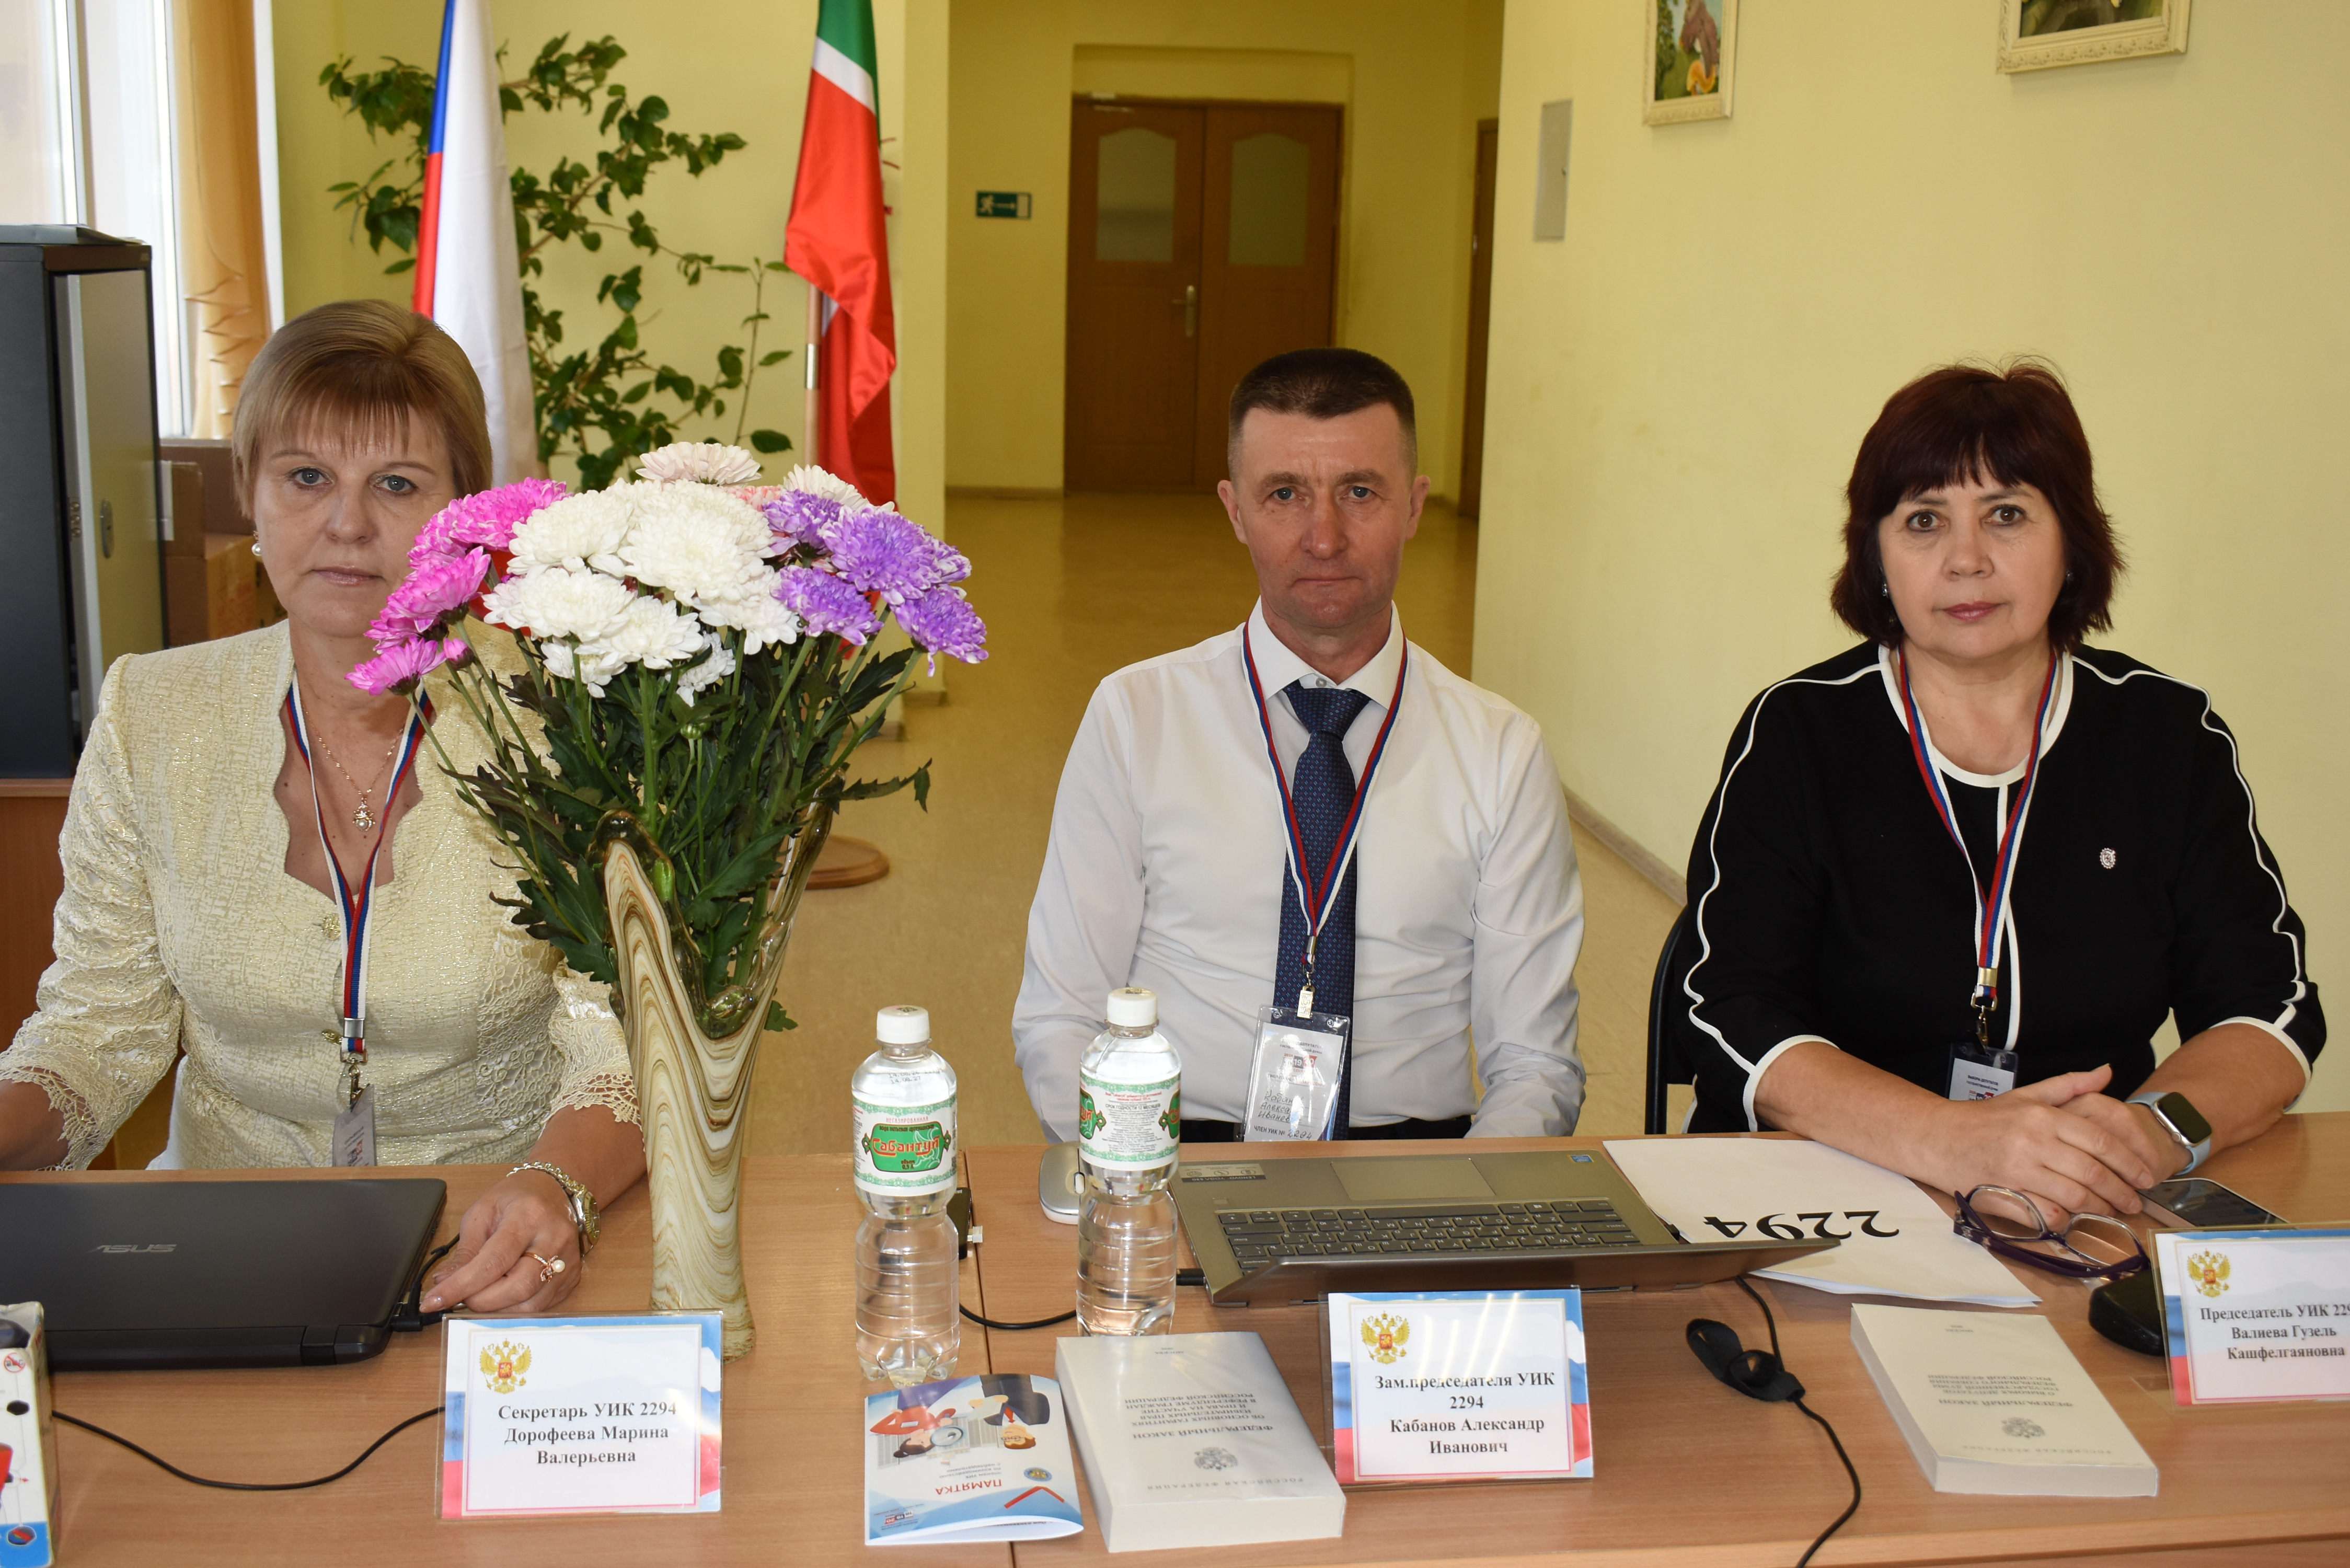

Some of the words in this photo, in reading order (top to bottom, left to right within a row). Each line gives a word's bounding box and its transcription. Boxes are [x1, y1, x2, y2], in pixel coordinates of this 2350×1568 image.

[872, 1136, 940, 1157] Сабантуй
[1703, 1210, 1900, 1240] 2294
[86, 1244, 177, 1253] ASUS
[2200, 1307, 2293, 1323] Председатель
[2296, 1305, 2329, 1317] УИК
[2231, 1327, 2288, 1340] Валиева
[2291, 1325, 2337, 1341] Гузель
[2227, 1347, 2345, 1362] Кашфелгаяновна
[1374, 1374, 1512, 1392] Зам.председателя
[1517, 1371, 1556, 1387] УИК
[1449, 1395, 1484, 1410] 2294
[498, 1404, 588, 1422] Секретарь
[593, 1401, 635, 1417] УИК
[639, 1401, 677, 1416] 2294
[1167, 1409, 1251, 1417] ИЗБИРАТЕЛЬНЫХ
[1178, 1425, 1273, 1436] ФЕДЕРАЛЬНЫЙ
[1390, 1419, 1456, 1433] Кабанов
[1461, 1418, 1545, 1433] Александр
[504, 1427, 595, 1445] Дорофеева
[600, 1425, 669, 1442] Марина
[1429, 1440, 1508, 1454] Иванович
[536, 1450, 637, 1467] Валерьевна
[935, 1479, 1002, 1495] ПАМЯТКА
